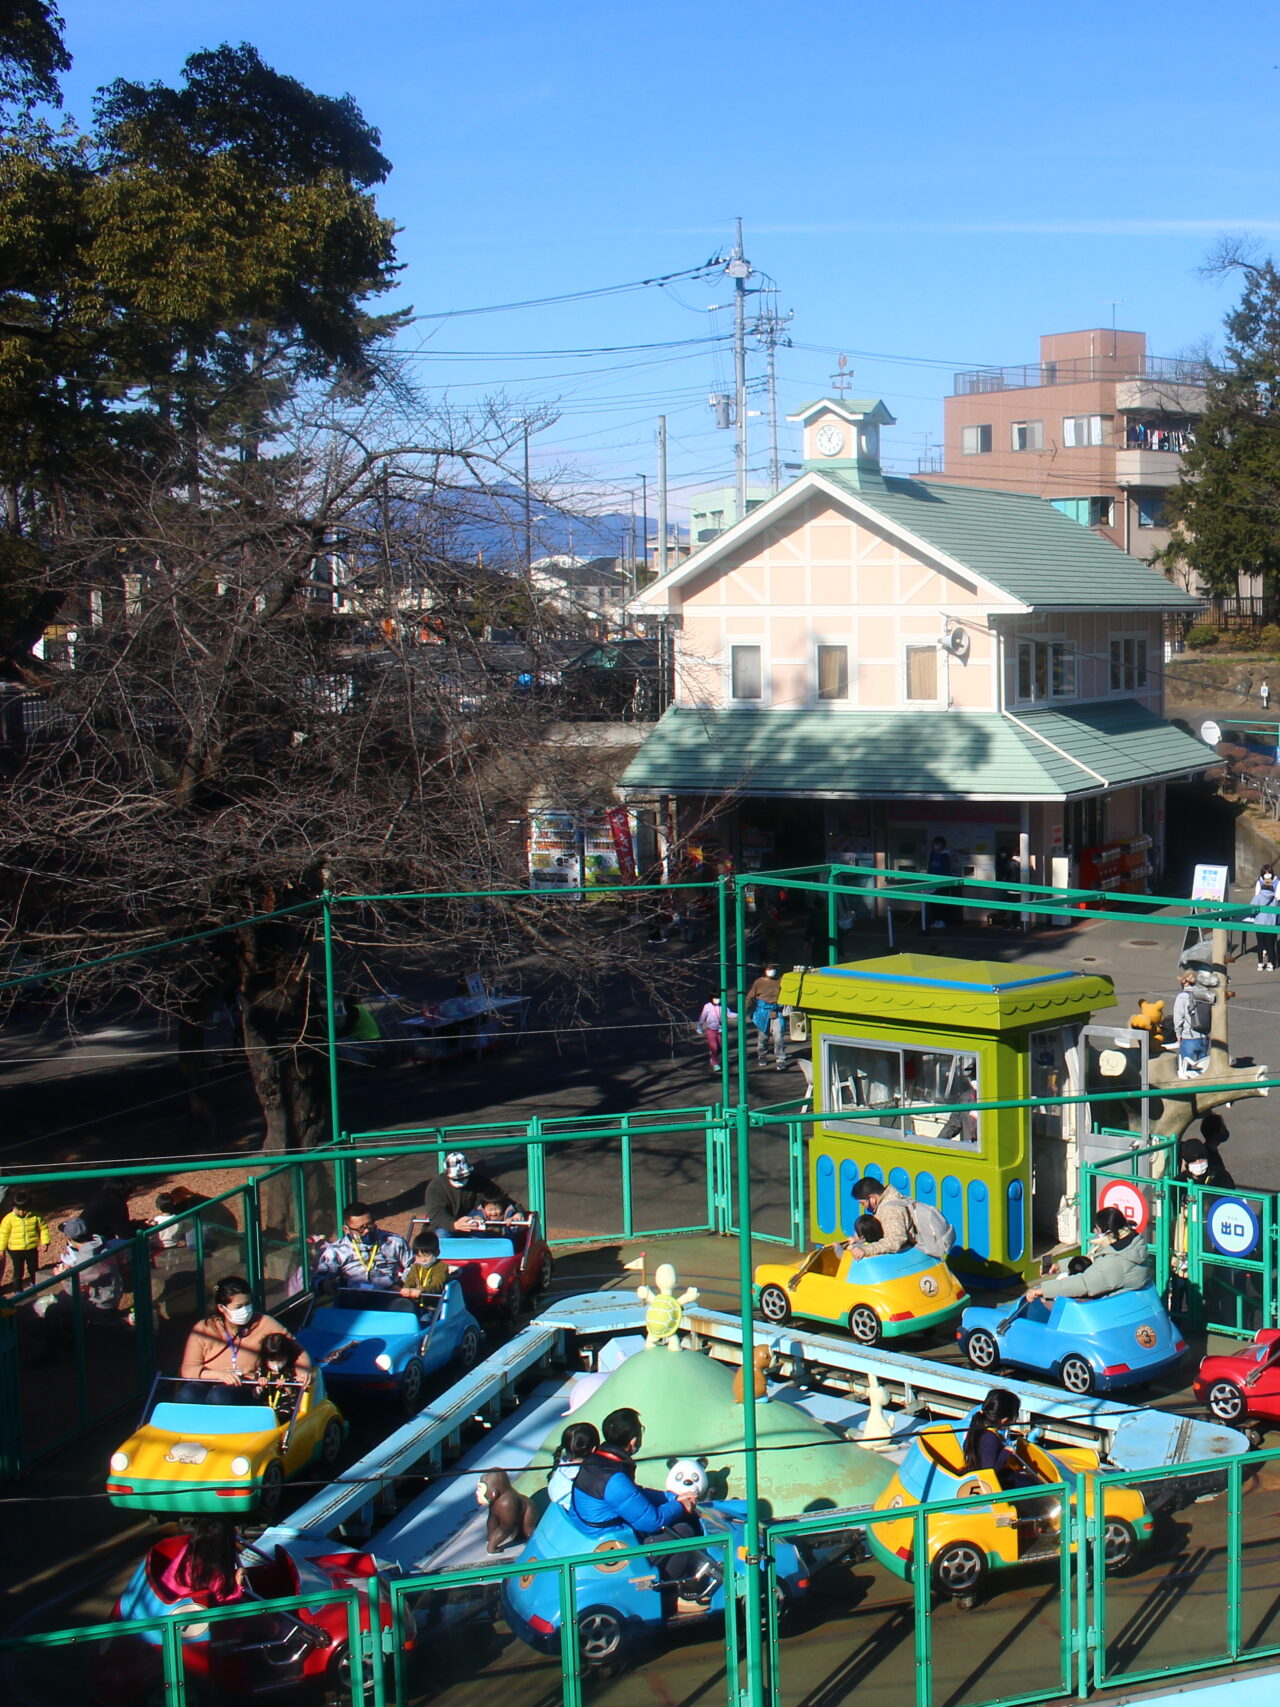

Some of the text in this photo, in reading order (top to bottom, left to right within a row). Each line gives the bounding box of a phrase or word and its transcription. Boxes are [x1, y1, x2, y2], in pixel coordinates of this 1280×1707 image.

[1220, 1221, 1245, 1237] 出口
[924, 1280, 935, 1294] 2
[1141, 1329, 1152, 1344] 3
